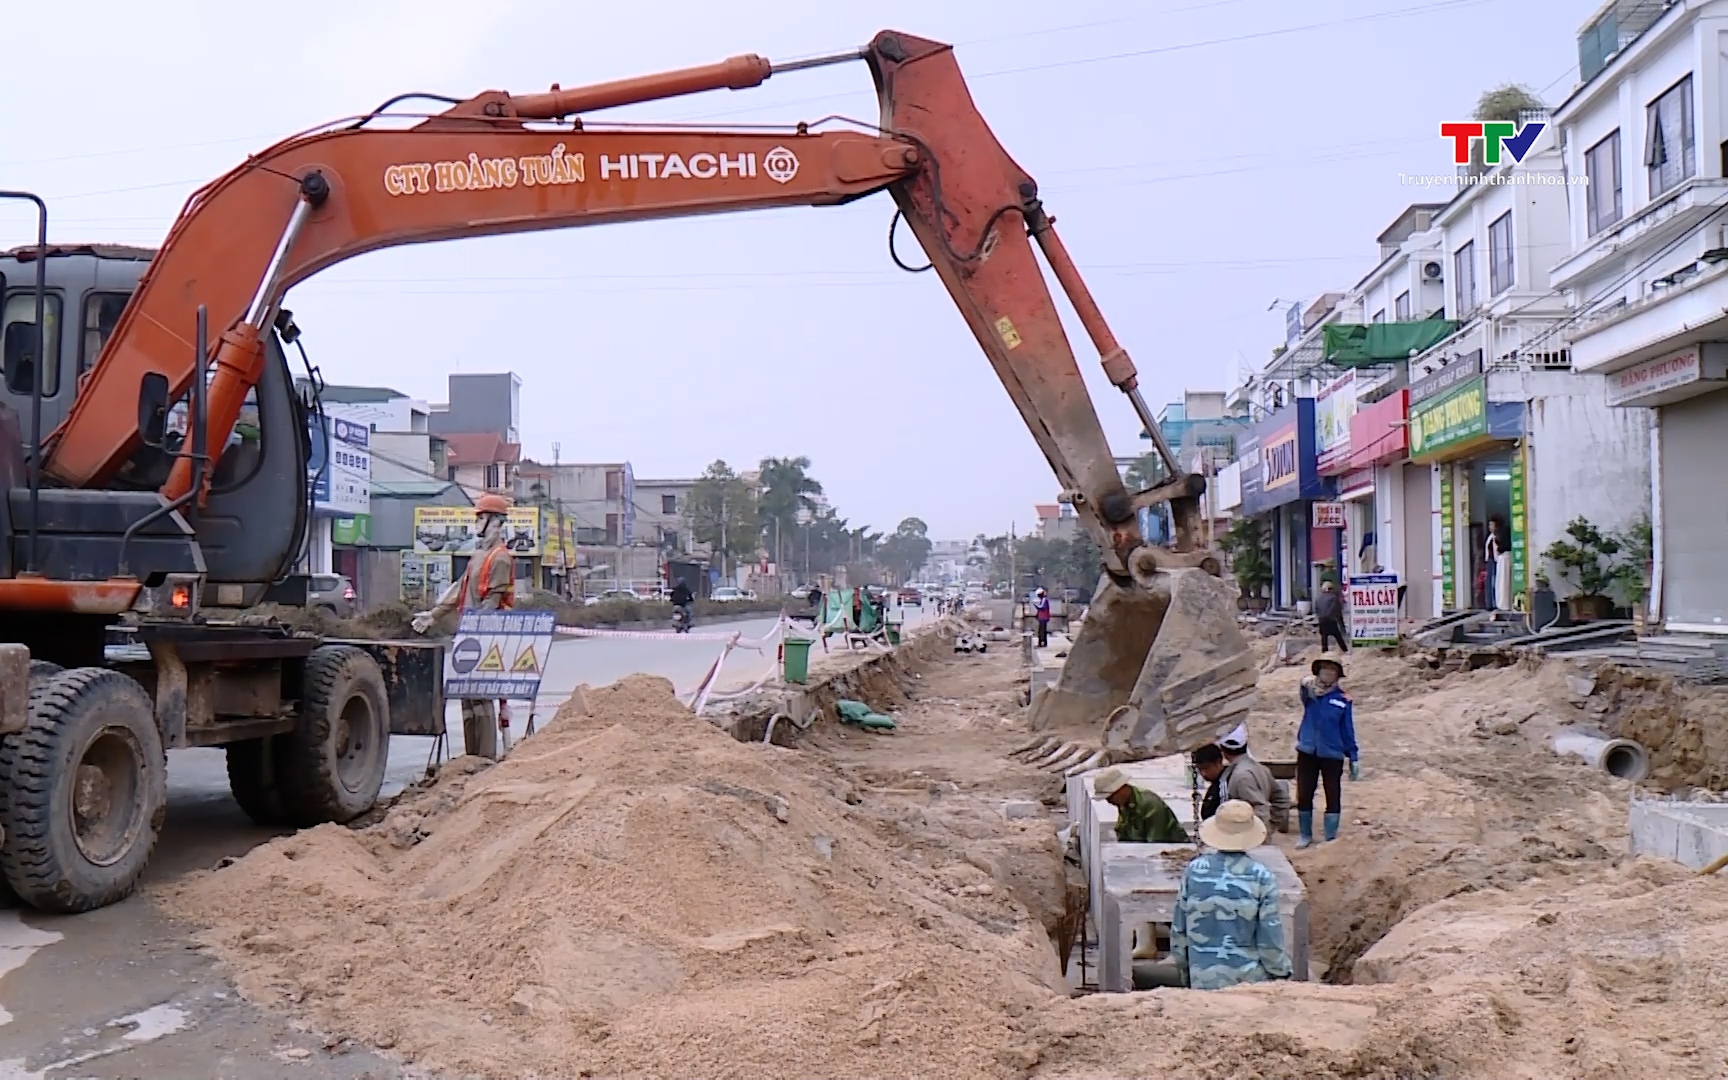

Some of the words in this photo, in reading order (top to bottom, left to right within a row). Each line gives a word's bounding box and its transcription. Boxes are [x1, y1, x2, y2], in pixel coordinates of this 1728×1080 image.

[384, 163, 431, 196] CTY
[436, 152, 518, 192] HOÀNG
[600, 152, 757, 180] HITACHI
[1352, 585, 1375, 606] TRÁI
[1377, 585, 1395, 606] CÂY
